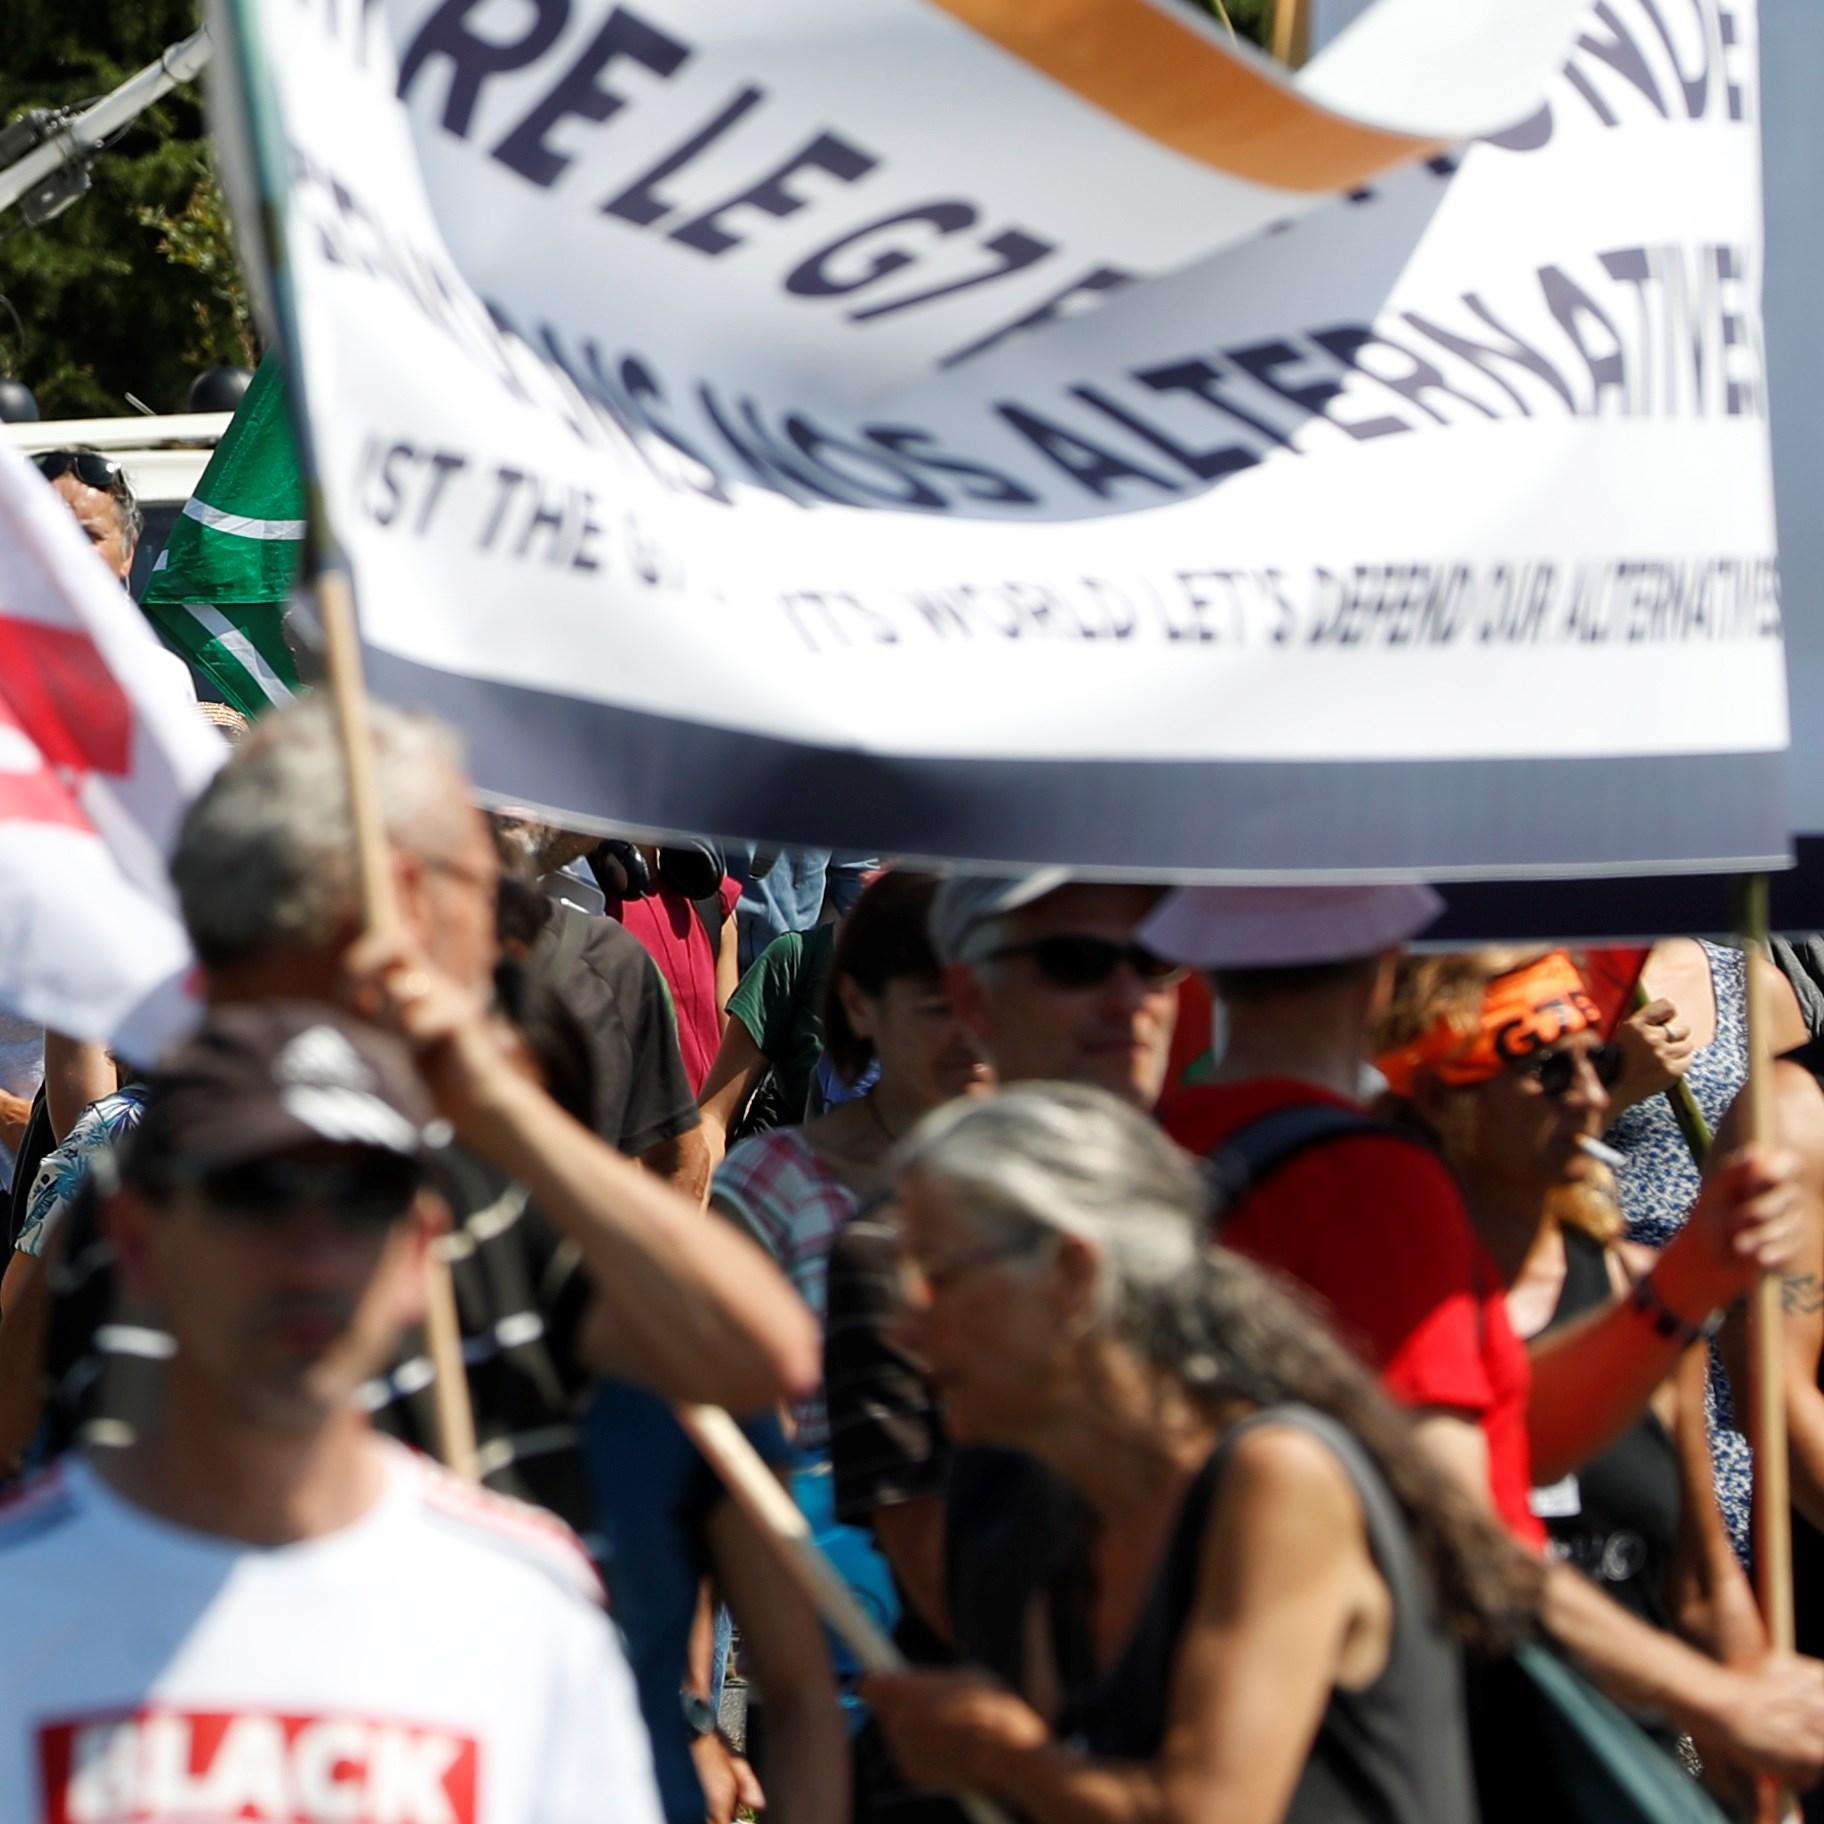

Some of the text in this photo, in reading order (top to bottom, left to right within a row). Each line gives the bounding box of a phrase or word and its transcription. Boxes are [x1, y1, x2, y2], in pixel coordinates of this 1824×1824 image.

[600, 82, 883, 256] LE
[782, 200, 1060, 322] G7
[479, 468, 602, 572] THE
[64, 1712, 464, 1822] BLACK
